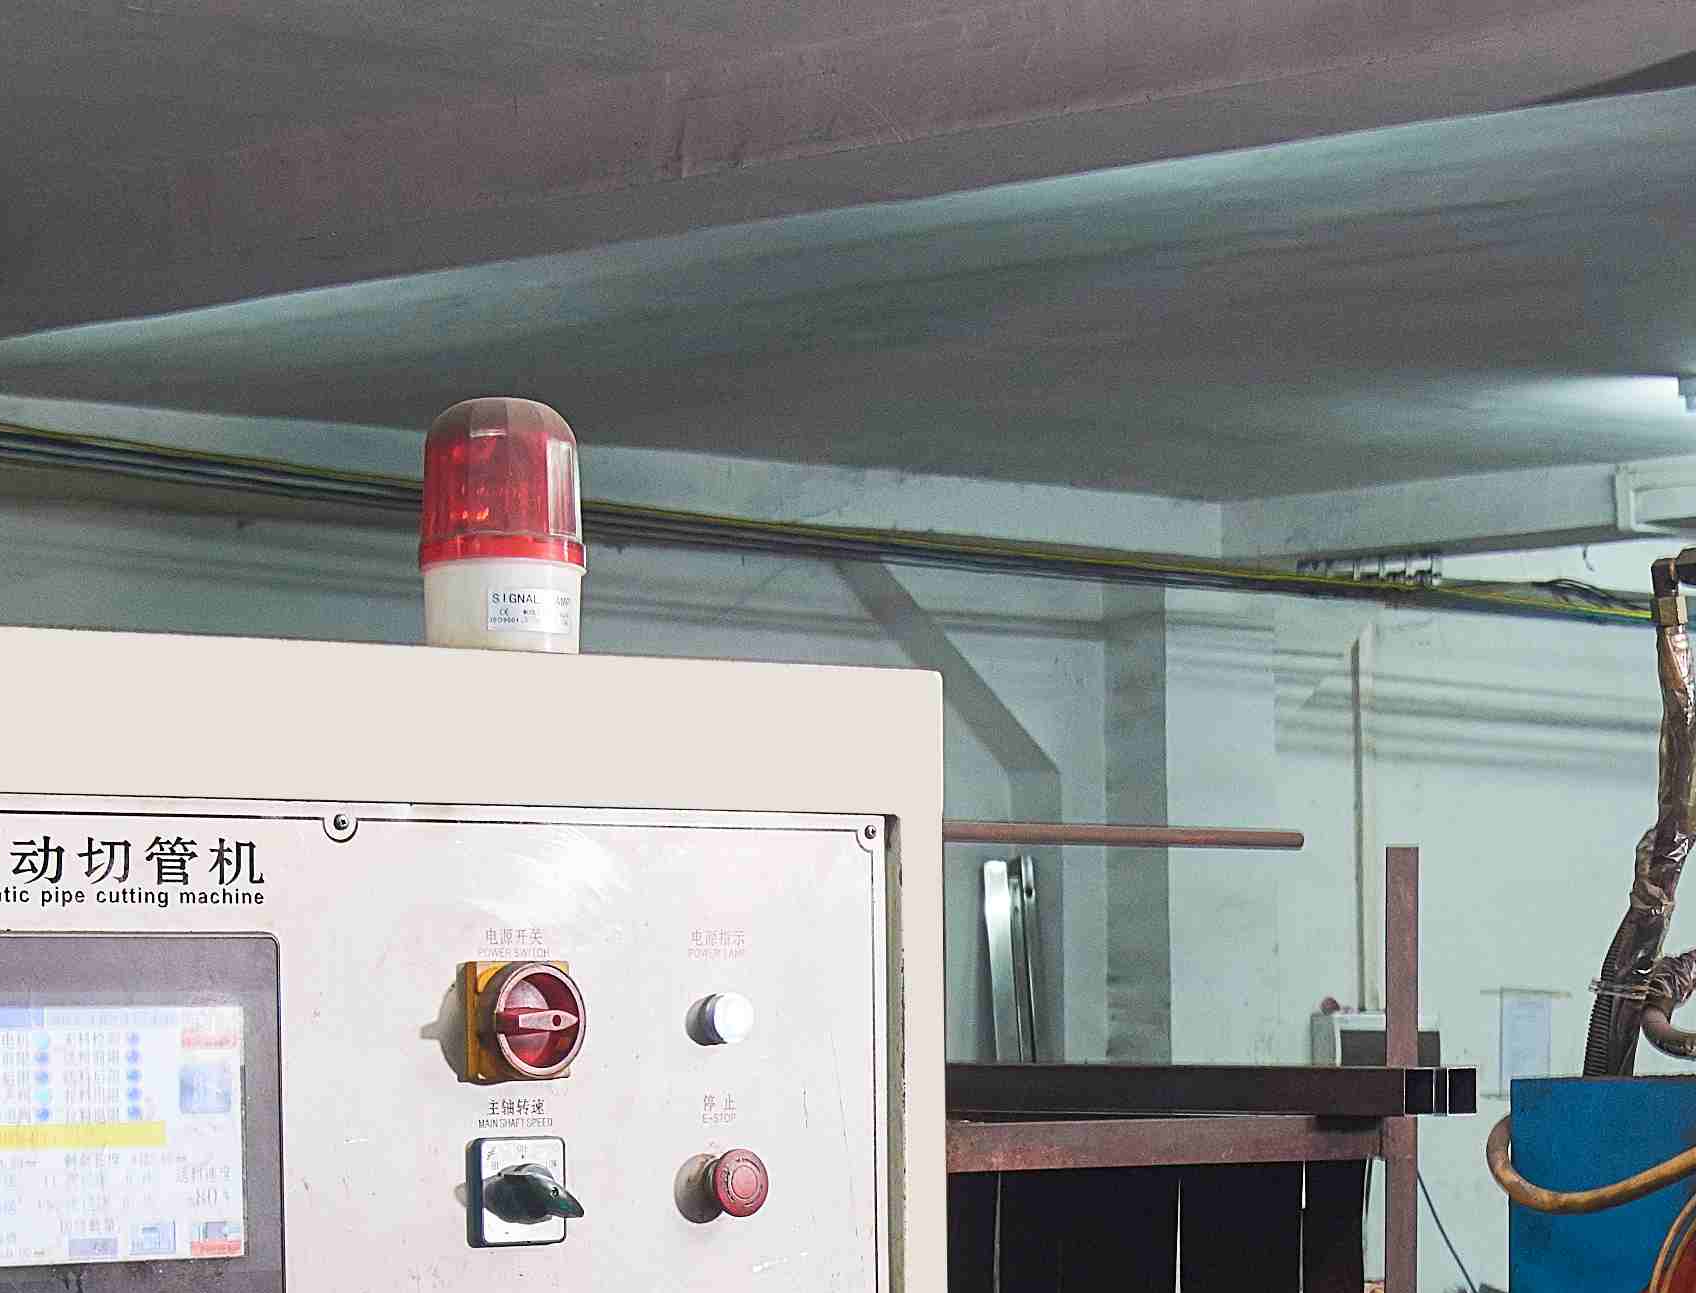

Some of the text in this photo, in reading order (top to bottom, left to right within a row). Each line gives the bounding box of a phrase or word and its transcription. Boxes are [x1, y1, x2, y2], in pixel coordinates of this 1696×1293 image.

[41, 887, 85, 907] pipe
[96, 886, 169, 908] cutting
[180, 887, 264, 905] machine
[486, 928, 544, 945] 电源开关
[691, 929, 745, 947] 电源指示
[488, 1098, 545, 1116] 主轴转速
[479, 1119, 498, 1129] MAIN
